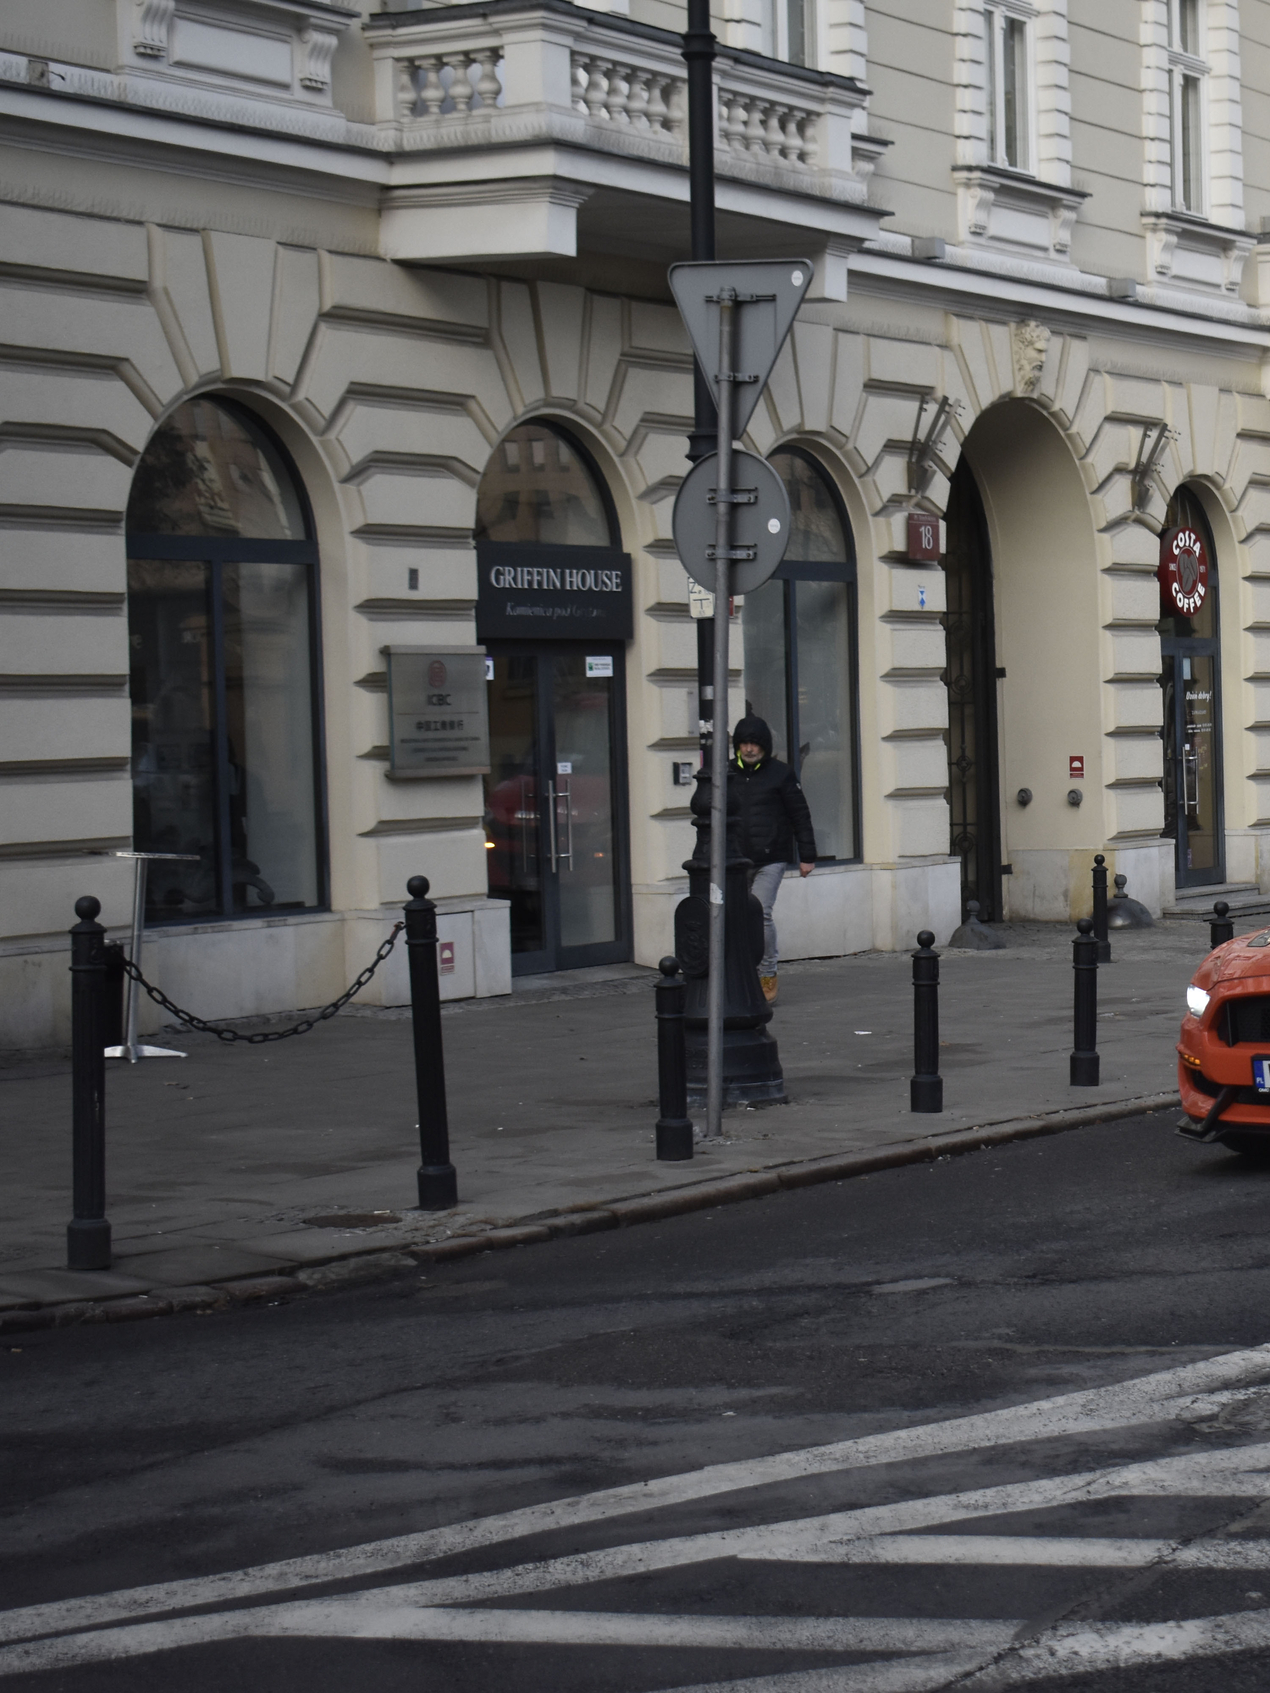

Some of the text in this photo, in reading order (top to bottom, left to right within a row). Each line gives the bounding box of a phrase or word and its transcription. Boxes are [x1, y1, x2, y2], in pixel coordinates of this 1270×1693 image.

[919, 525, 933, 549] 18
[1172, 530, 1202, 558] COSTA
[490, 566, 623, 592] GRIFFIN HOUSE
[1171, 582, 1206, 613] COFFEE
